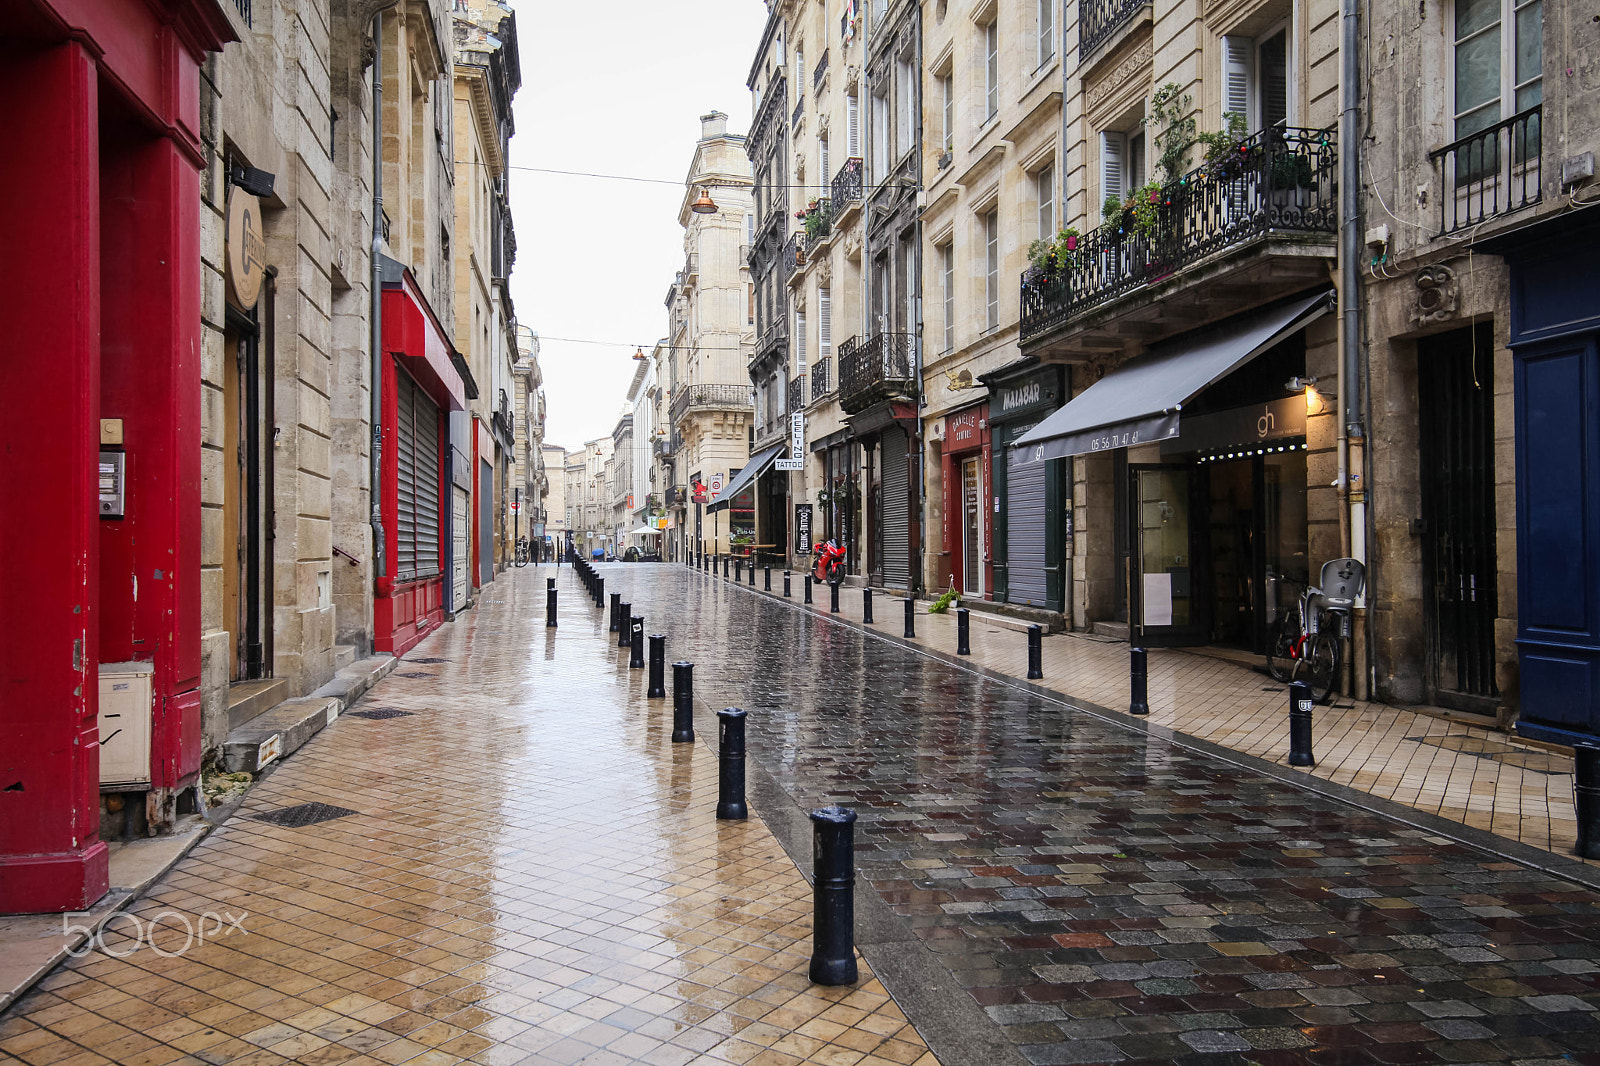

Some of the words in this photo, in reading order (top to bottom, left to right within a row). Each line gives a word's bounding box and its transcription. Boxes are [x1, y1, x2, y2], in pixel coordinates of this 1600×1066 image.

[1002, 383, 1040, 411] MALABAR
[1257, 405, 1275, 438] gh
[794, 415, 803, 459] FEELING
[1091, 439, 1099, 450] 05
[1101, 437, 1110, 449] 56
[1112, 435, 1119, 447] 70
[1122, 433, 1129, 445] 47
[800, 512, 809, 531] TATTOO
[800, 533, 809, 550] FEELING
